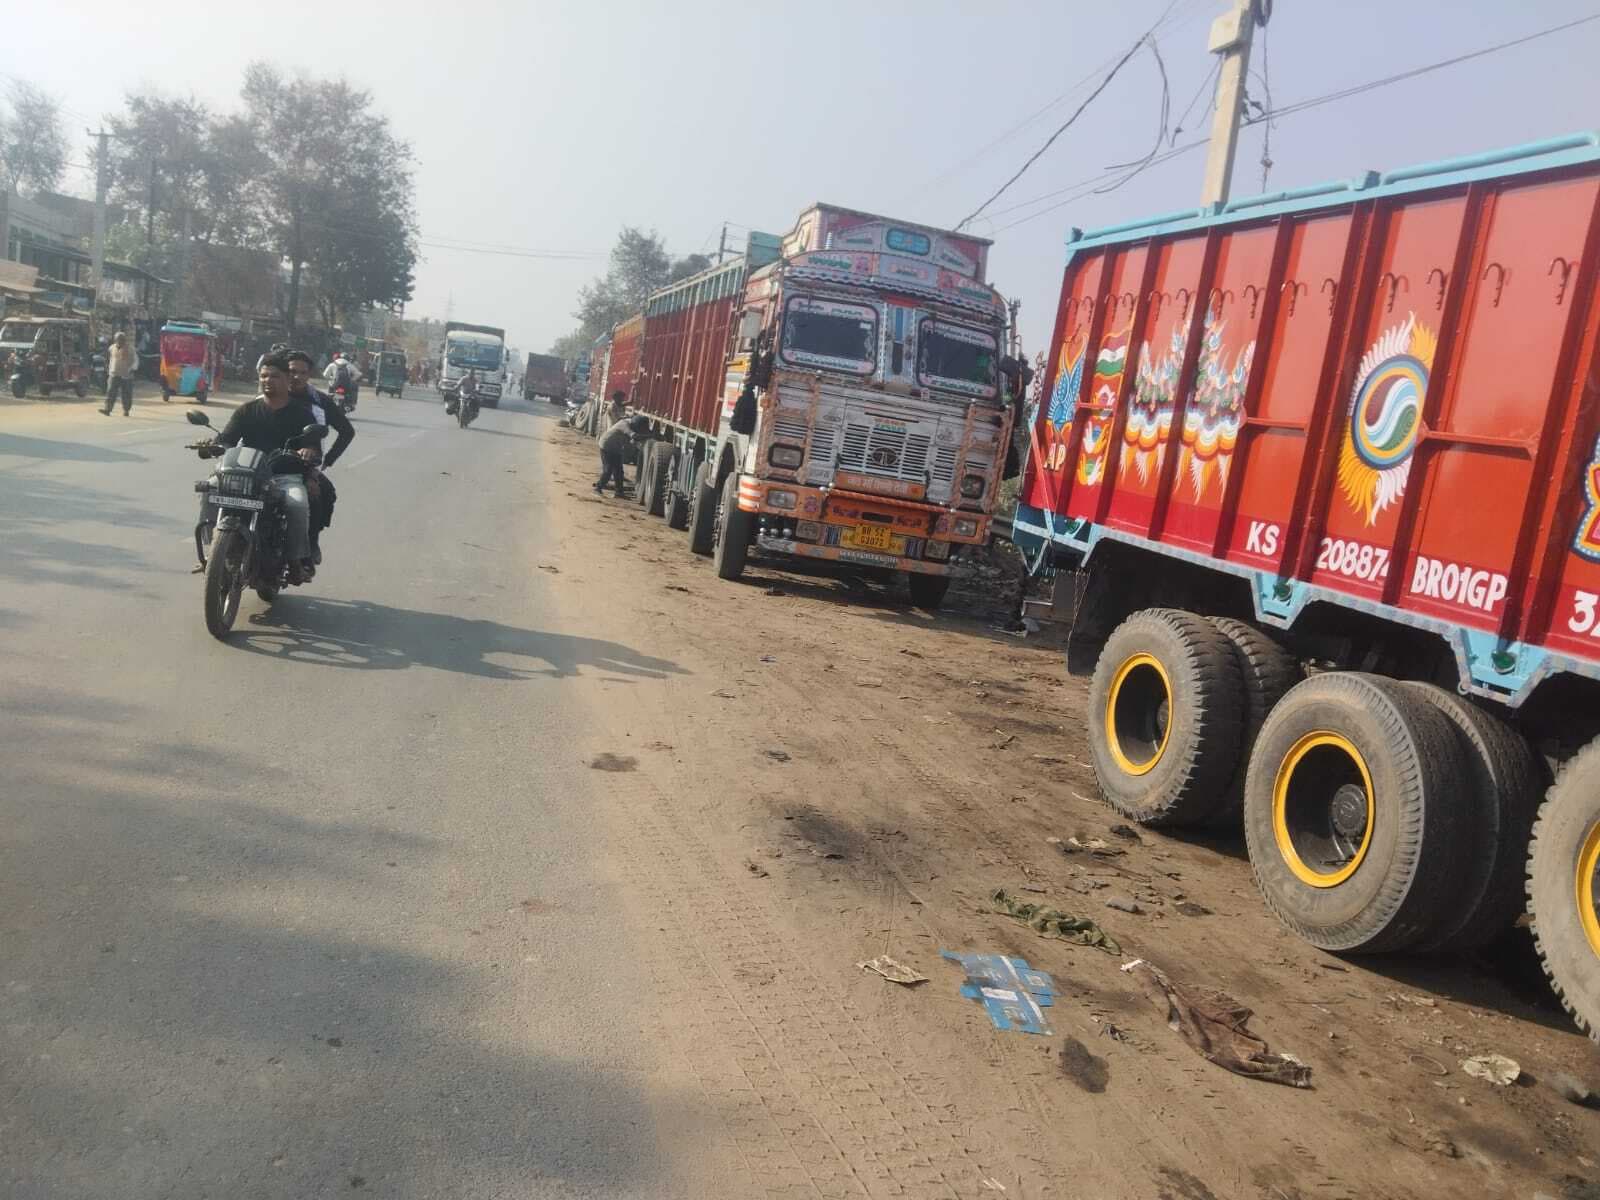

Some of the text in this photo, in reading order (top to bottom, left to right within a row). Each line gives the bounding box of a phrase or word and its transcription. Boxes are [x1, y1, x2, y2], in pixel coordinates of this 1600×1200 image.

[1246, 521, 1280, 556] KS
[1410, 556, 1508, 612] BR01GP
[1567, 590, 1600, 638] 3
